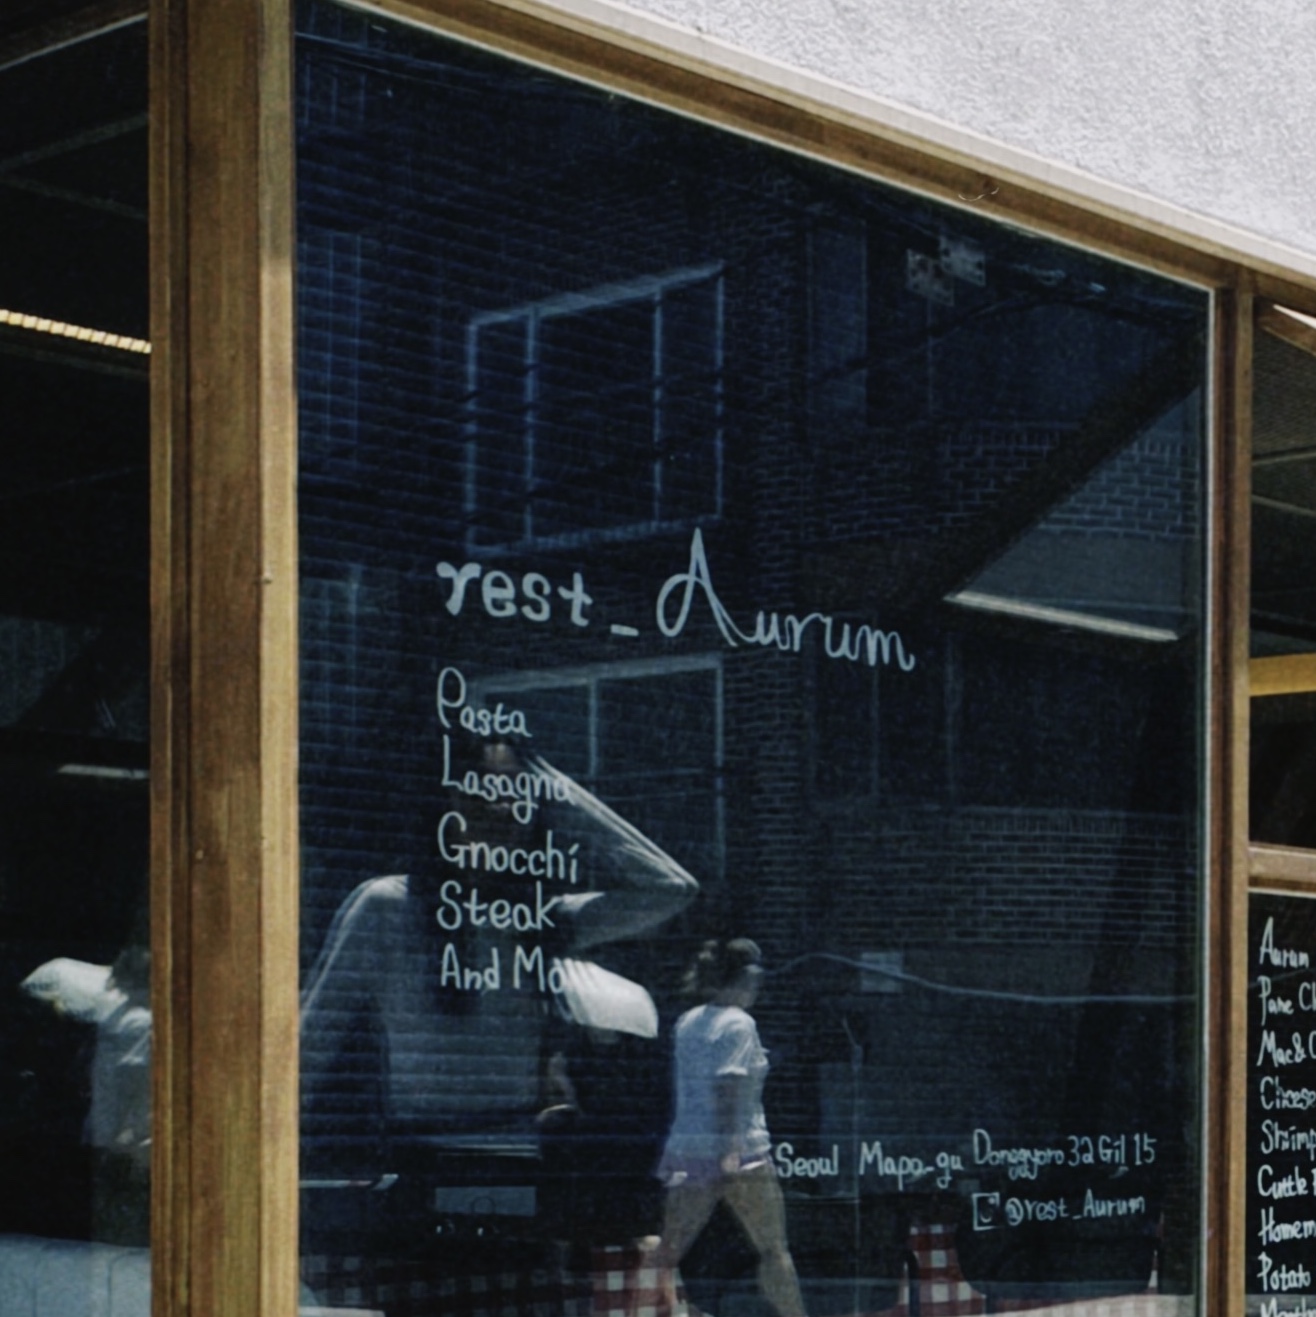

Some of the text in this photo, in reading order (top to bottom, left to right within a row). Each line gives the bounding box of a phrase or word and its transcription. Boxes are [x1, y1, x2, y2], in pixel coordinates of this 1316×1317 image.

[436, 667, 533, 738] Pasta
[441, 734, 578, 825] Lasagna
[437, 811, 581, 884] Gnocchi
[436, 880, 556, 931] Steak
[440, 942, 500, 991] And
[1259, 1074, 1316, 1111] Cheese
[774, 1140, 840, 1179] Seoul
[1098, 1134, 1127, 1166] Gil
[1133, 1132, 1158, 1166] 15
[1257, 1163, 1309, 1200] Cuttle
[1256, 1250, 1312, 1292] Potato
